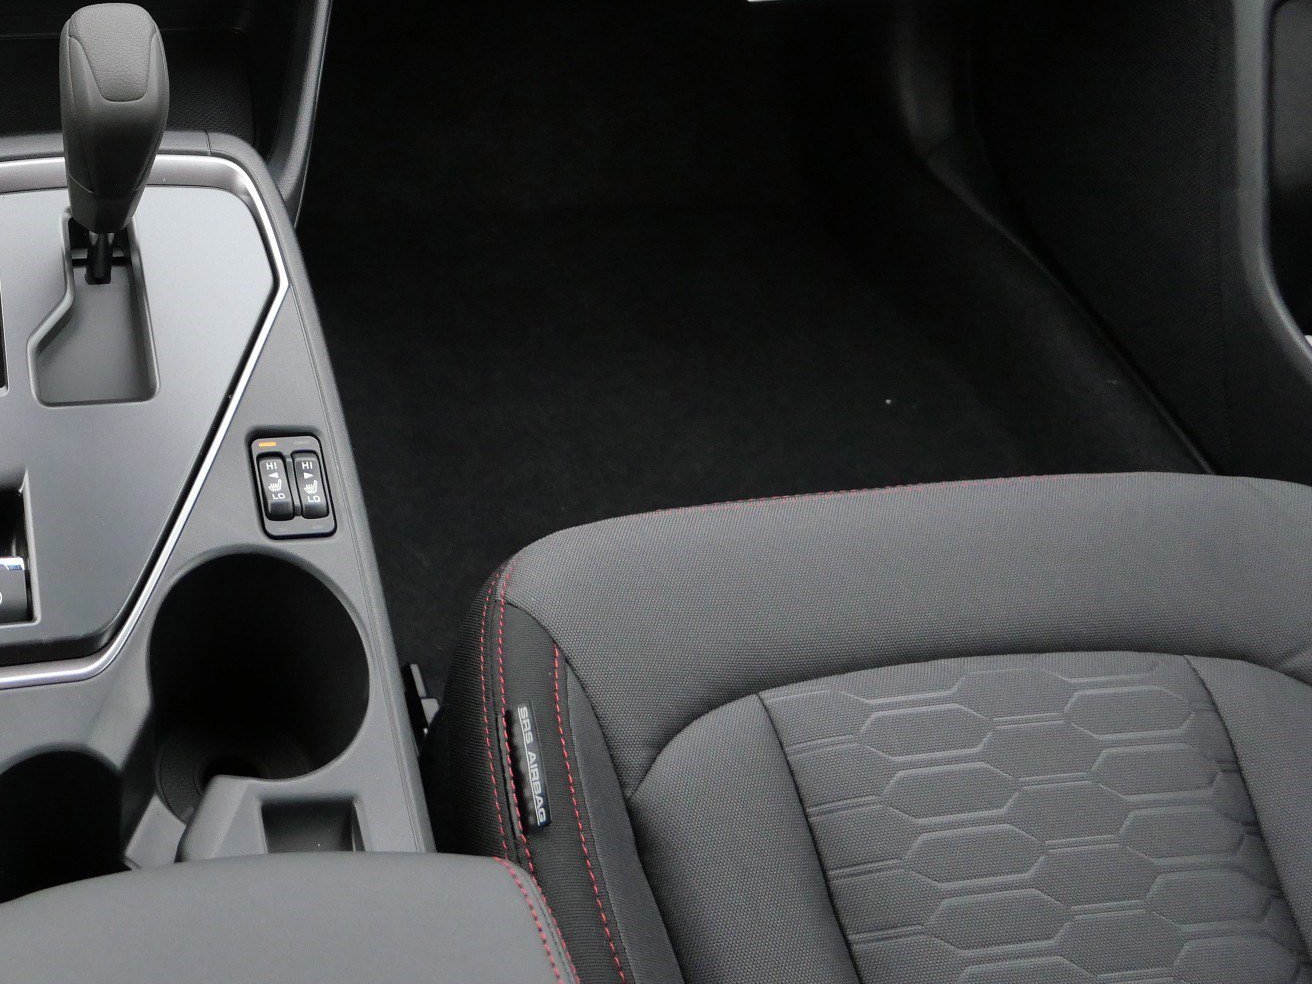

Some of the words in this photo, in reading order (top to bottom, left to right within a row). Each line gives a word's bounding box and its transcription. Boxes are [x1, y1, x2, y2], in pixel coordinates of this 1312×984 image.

[266, 461, 277, 470] HI
[301, 461, 313, 470] HI
[307, 495, 321, 503] LO
[519, 706, 533, 744] SRS
[527, 751, 546, 822] AIRBAG
